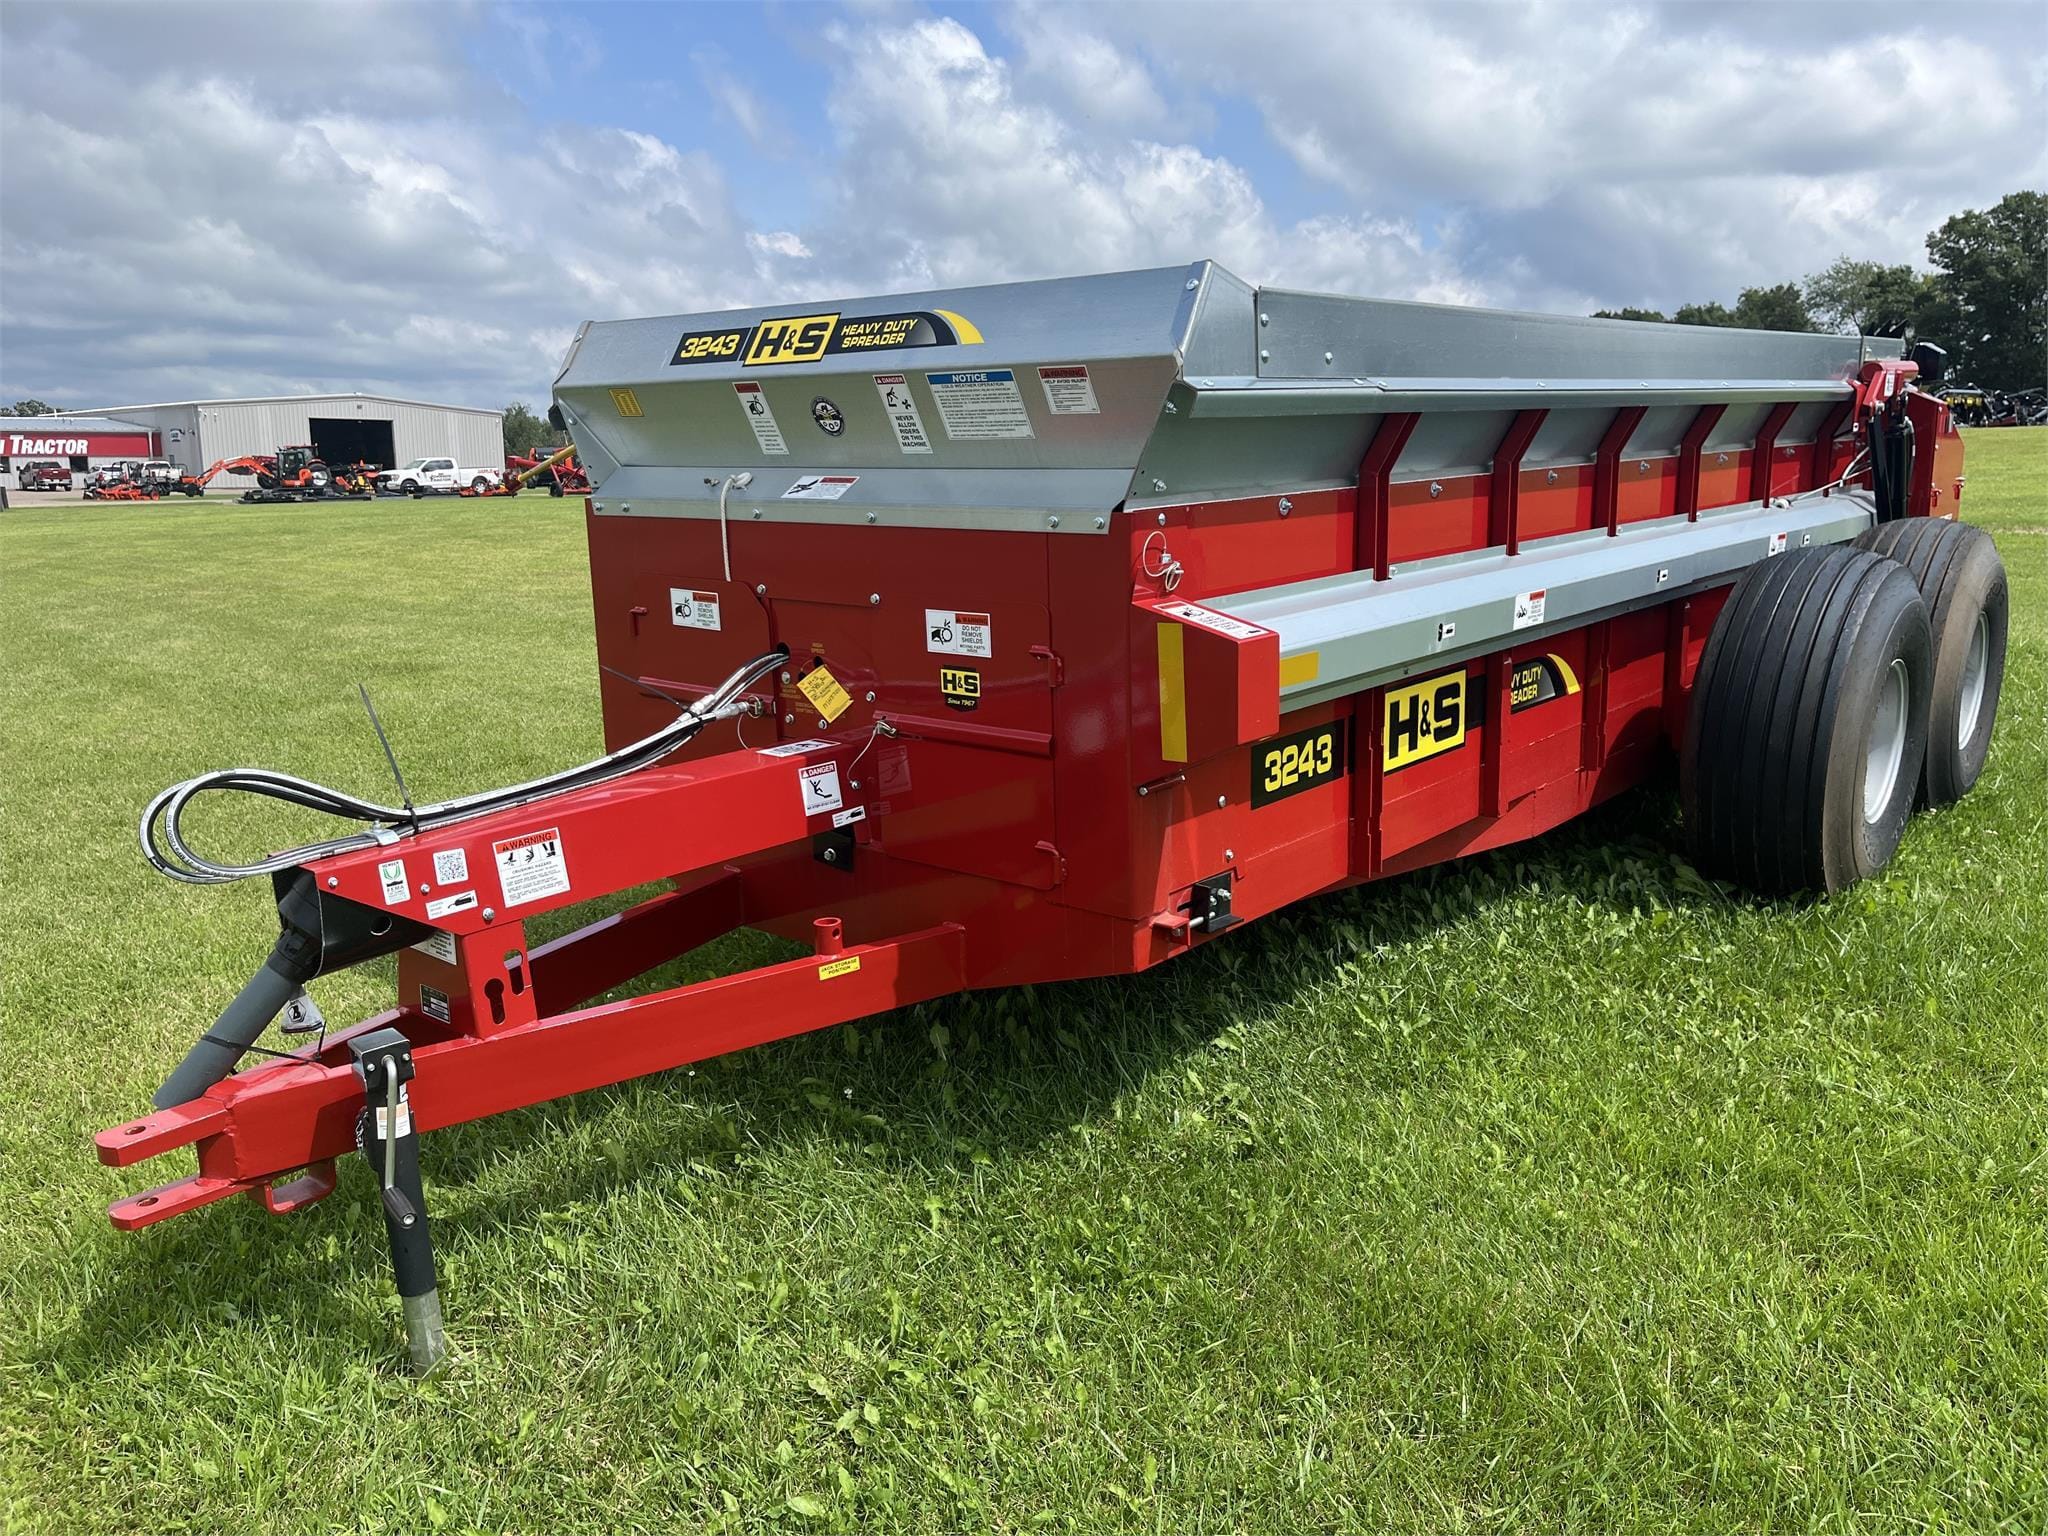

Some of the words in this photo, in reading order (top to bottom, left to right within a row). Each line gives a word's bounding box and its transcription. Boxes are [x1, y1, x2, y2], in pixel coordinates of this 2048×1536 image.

[841, 322, 882, 336] HEAVY
[883, 319, 918, 332] DUTY
[680, 335, 741, 358] 3243
[751, 322, 831, 359] H&S
[841, 333, 906, 348] SPREADER
[881, 376, 904, 384] DANGER
[952, 373, 988, 383] NOTICE
[10, 435, 89, 454] TRACTOR
[943, 672, 978, 694] H&S
[1522, 665, 1543, 684] DUTY
[1388, 681, 1461, 759] H&S
[808, 764, 834, 776] DANGER
[1264, 733, 1333, 792] 3243
[510, 832, 552, 849] WARNING
